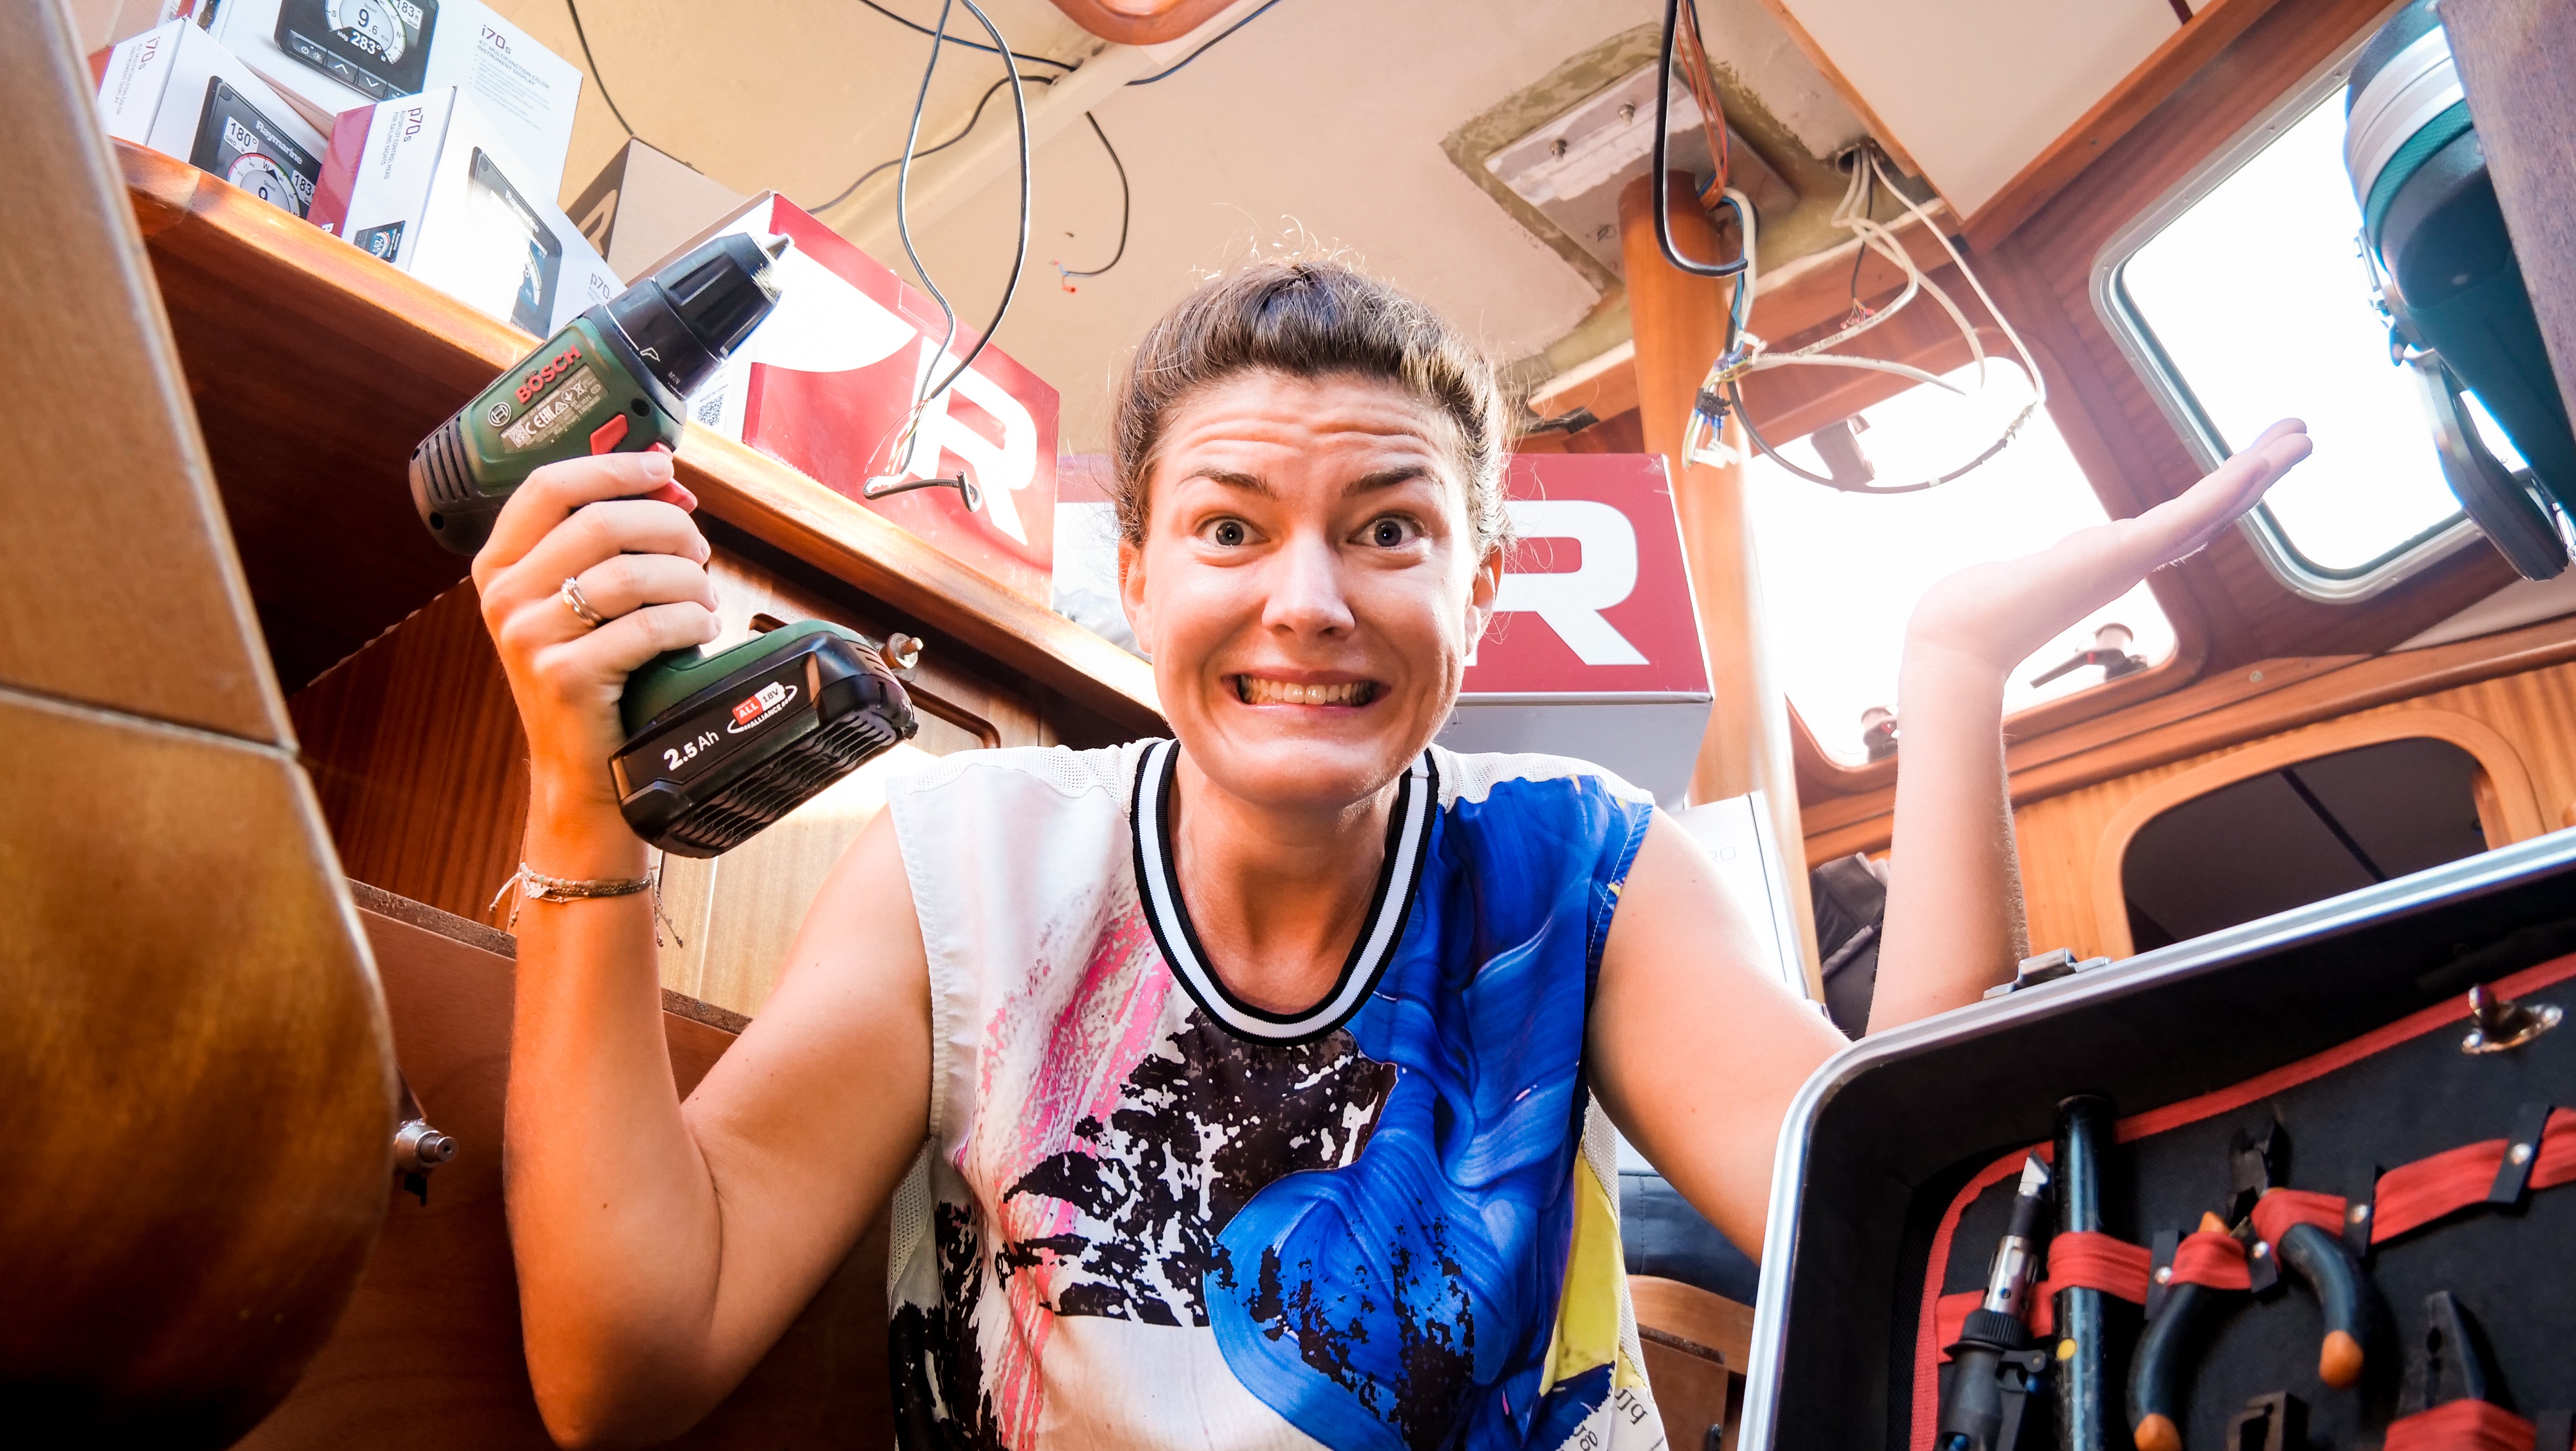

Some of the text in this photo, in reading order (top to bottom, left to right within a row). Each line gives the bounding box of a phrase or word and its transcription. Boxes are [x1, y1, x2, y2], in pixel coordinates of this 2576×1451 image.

[336, 30, 349, 42] Hdg
[482, 24, 511, 55] i70s
[139, 36, 160, 70] i70s
[477, 45, 536, 86] INSTRUMENT DISPLAY
[489, 46, 531, 78] MULTIFUNCTION
[532, 75, 550, 89] COLOR
[386, 123, 396, 144] SAILING
[395, 110, 406, 138] AUTOPILOT
[403, 107, 423, 142] p70s
[255, 120, 303, 164] Raymarine
[380, 145, 390, 165] YACHTS
[388, 139, 399, 164] CONTROL
[384, 164, 392, 179] HEAD
[590, 273, 612, 299] p70
[515, 344, 582, 404] BOSCH
[909, 336, 1038, 546] R
[1463, 500, 1650, 665] R
[763, 688, 778, 703] 18V
[739, 702, 759, 719] ALL
[750, 704, 783, 728] ALLIANCE
